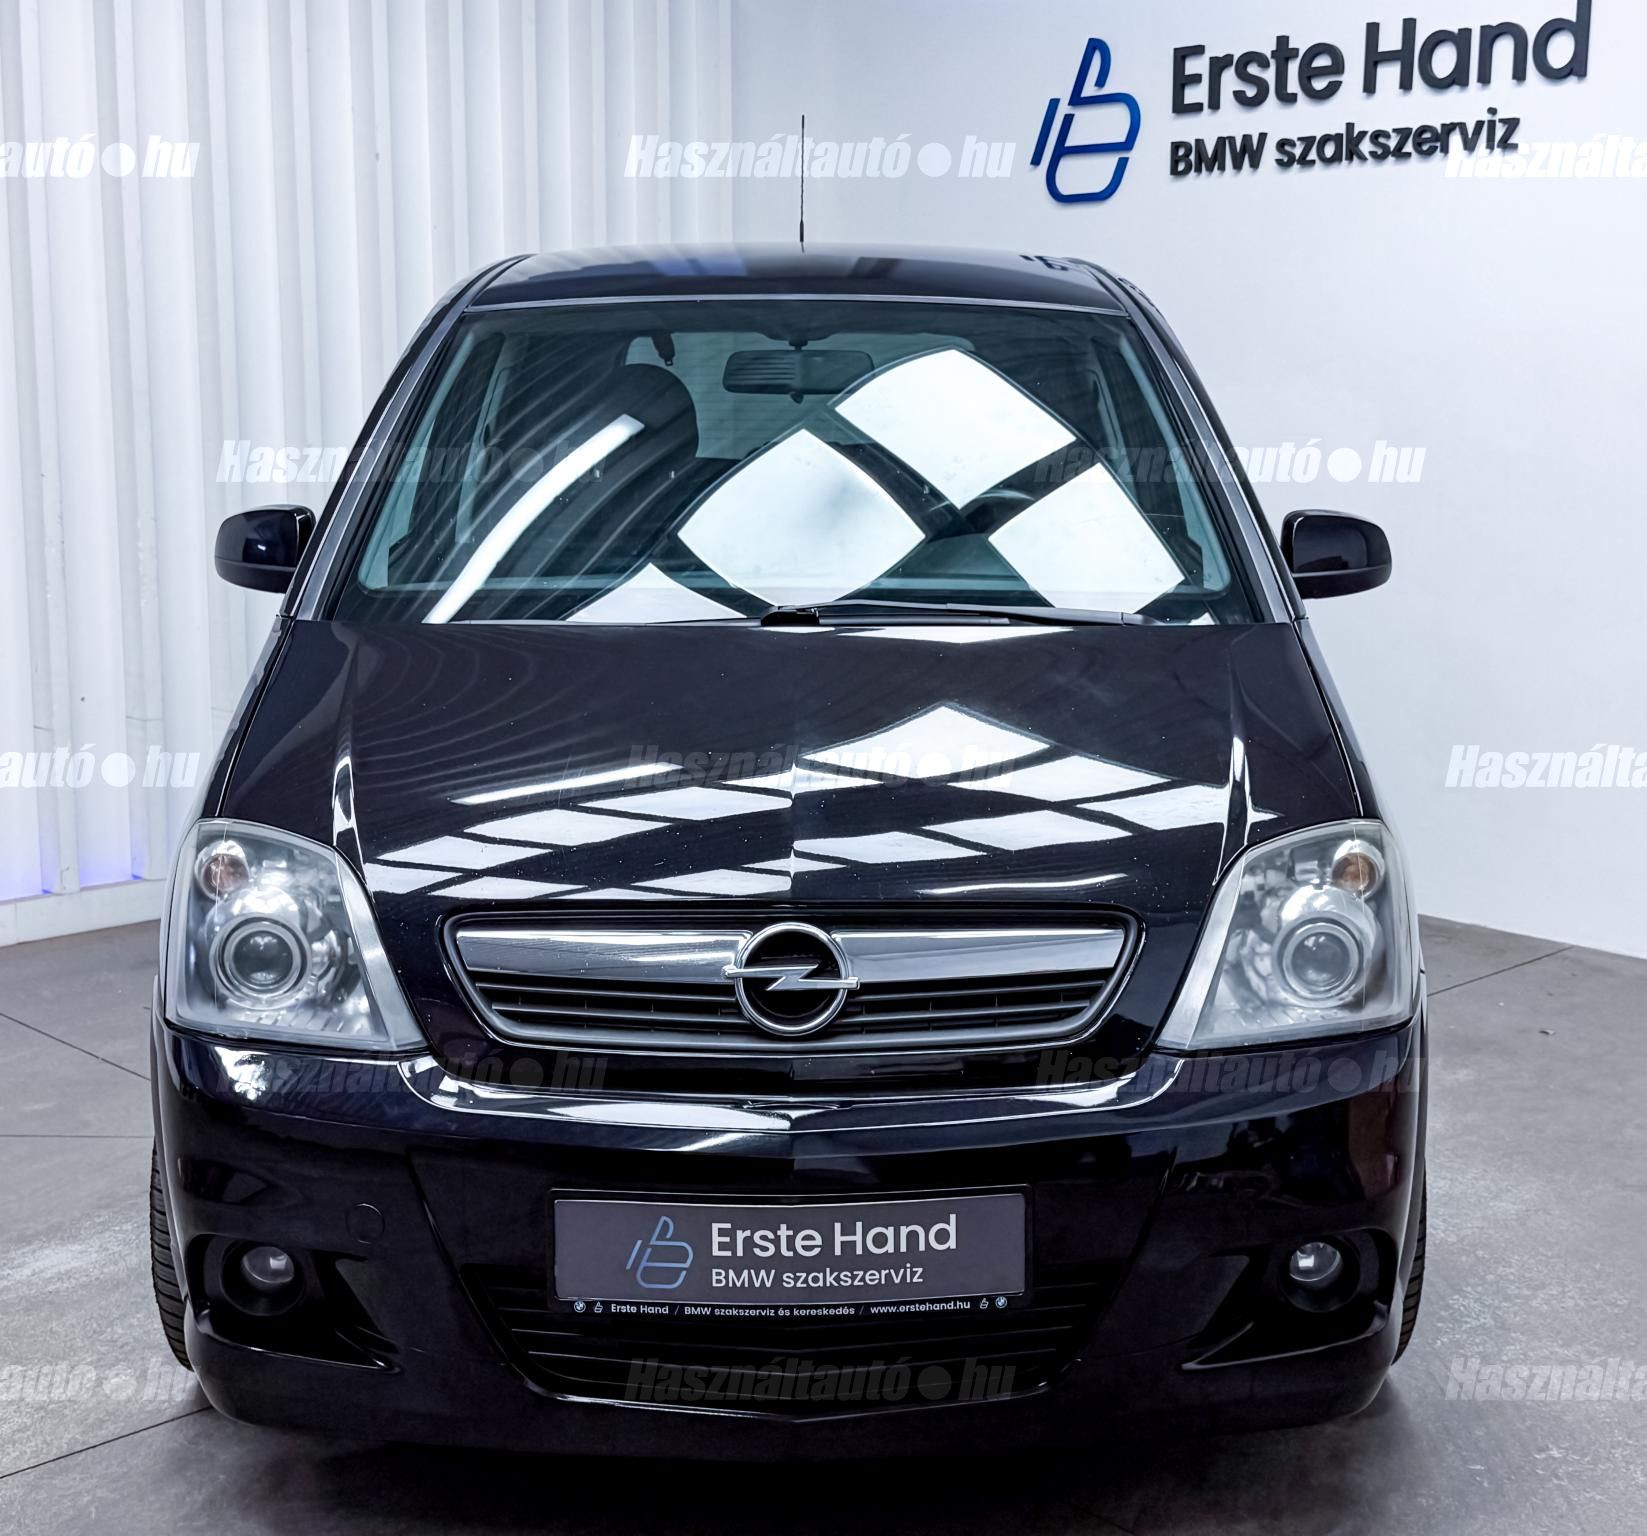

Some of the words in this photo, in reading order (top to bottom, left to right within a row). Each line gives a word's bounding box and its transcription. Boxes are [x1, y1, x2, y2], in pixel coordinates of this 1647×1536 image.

[1172, 35, 1345, 114] Erste
[1362, 0, 1592, 95] Hand
[1170, 132, 1268, 177] BMW
[1275, 106, 1520, 169] szakszerviz
[711, 1222, 823, 1258] Erste
[834, 1213, 957, 1256] Hand
[711, 1268, 776, 1288] BMW
[782, 1262, 924, 1288] szakszerviz
[611, 1303, 637, 1313] Erste
[640, 1304, 669, 1314] Hand
[684, 1306, 712, 1315] BMW
[714, 1307, 775, 1317] szakszerviz
[778, 1307, 790, 1316] és
[793, 1306, 855, 1316] kereskedés
[870, 1300, 971, 1314] www.erstehand.hu
